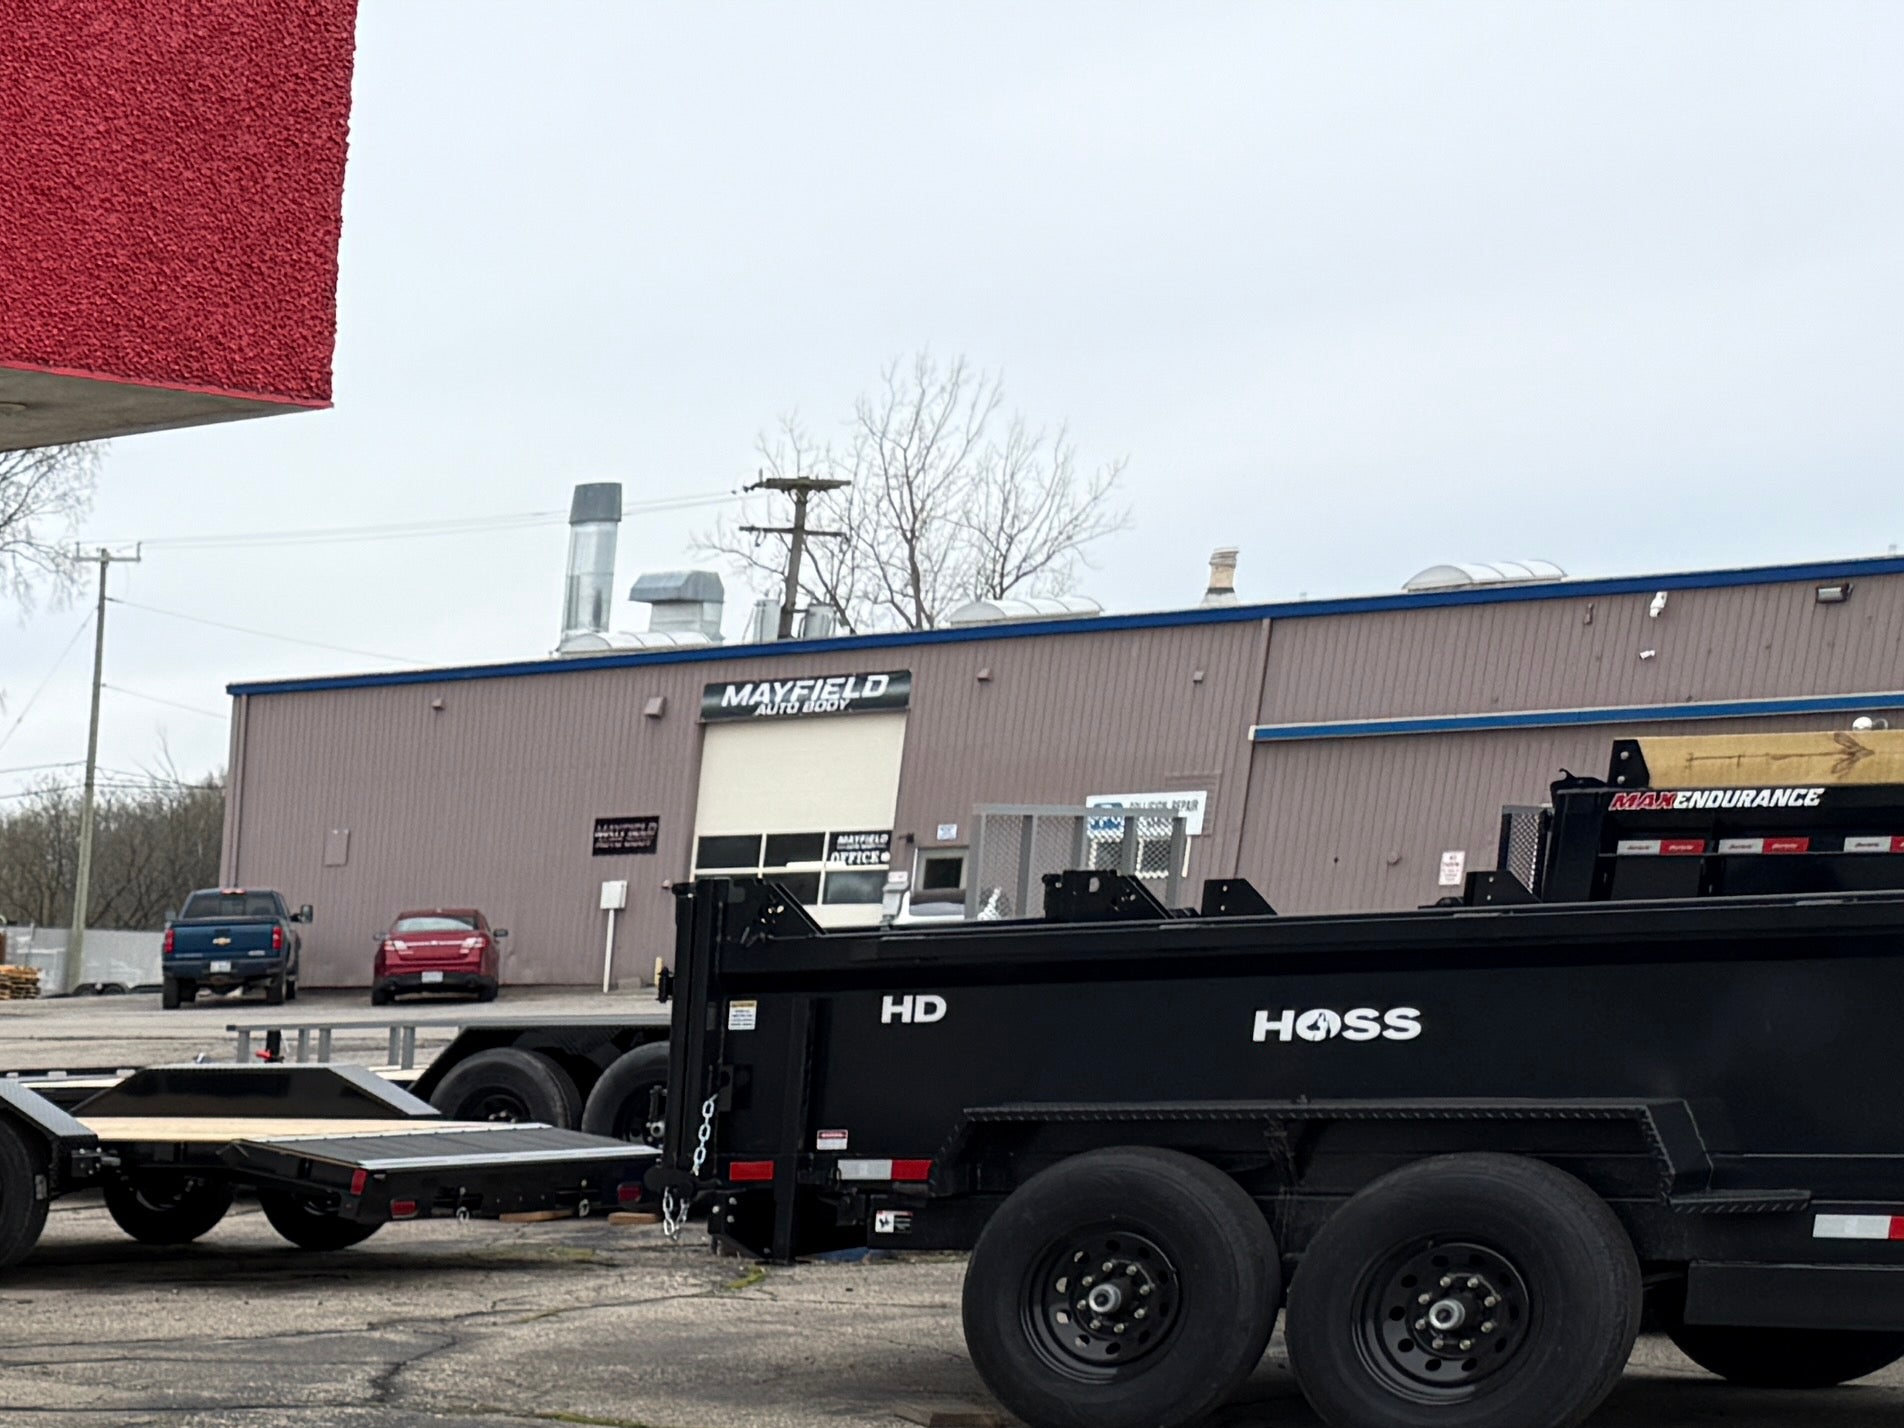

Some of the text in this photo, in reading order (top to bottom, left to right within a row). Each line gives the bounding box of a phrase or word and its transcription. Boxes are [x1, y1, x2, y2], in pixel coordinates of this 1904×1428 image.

[721, 674, 890, 707] MAYFIELD
[754, 698, 851, 716] AUTO BODY
[831, 850, 880, 865] OFFICE
[881, 995, 947, 1024] HD
[1252, 1006, 1422, 1042] HOSS
